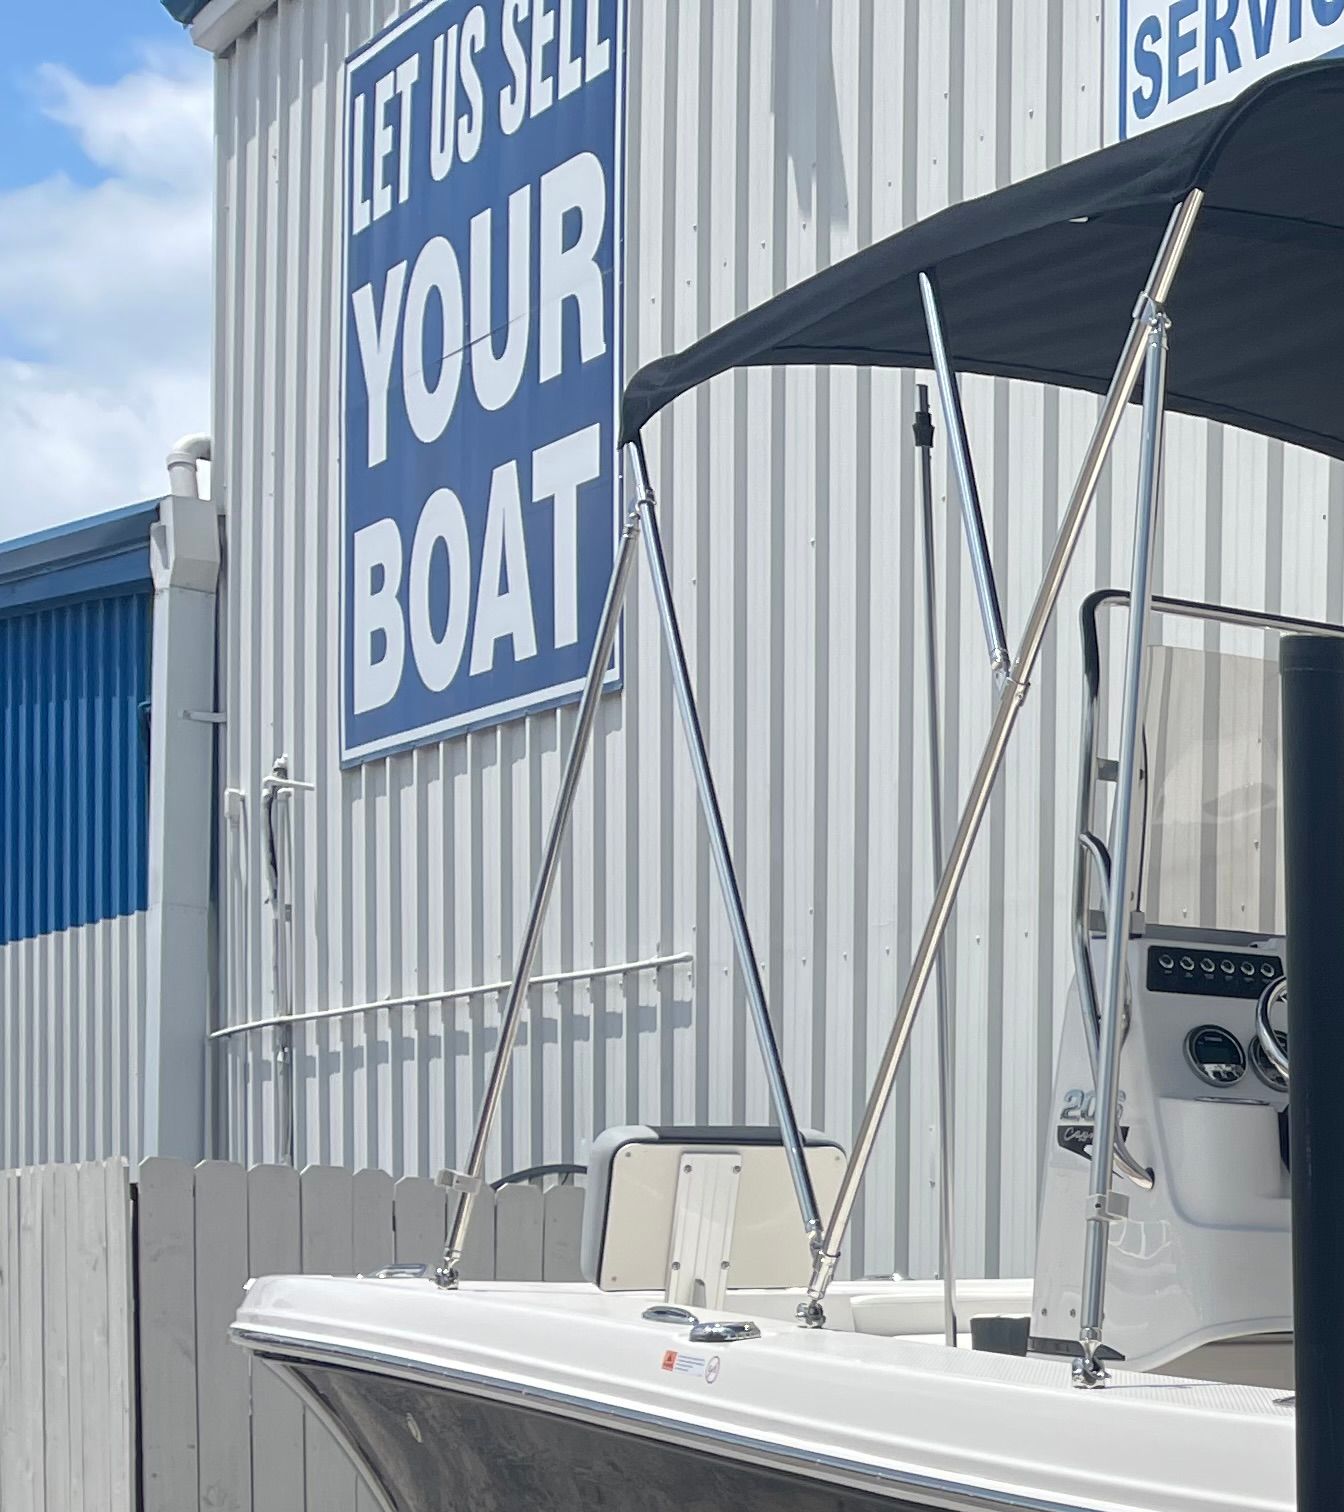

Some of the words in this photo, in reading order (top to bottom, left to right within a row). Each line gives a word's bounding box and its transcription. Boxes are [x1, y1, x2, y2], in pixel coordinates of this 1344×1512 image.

[352, 53, 419, 235] LET
[430, 5, 486, 181] US
[500, 0, 610, 135] SELL
[352, 151, 607, 468] YOUR
[353, 422, 600, 714] BOAT
